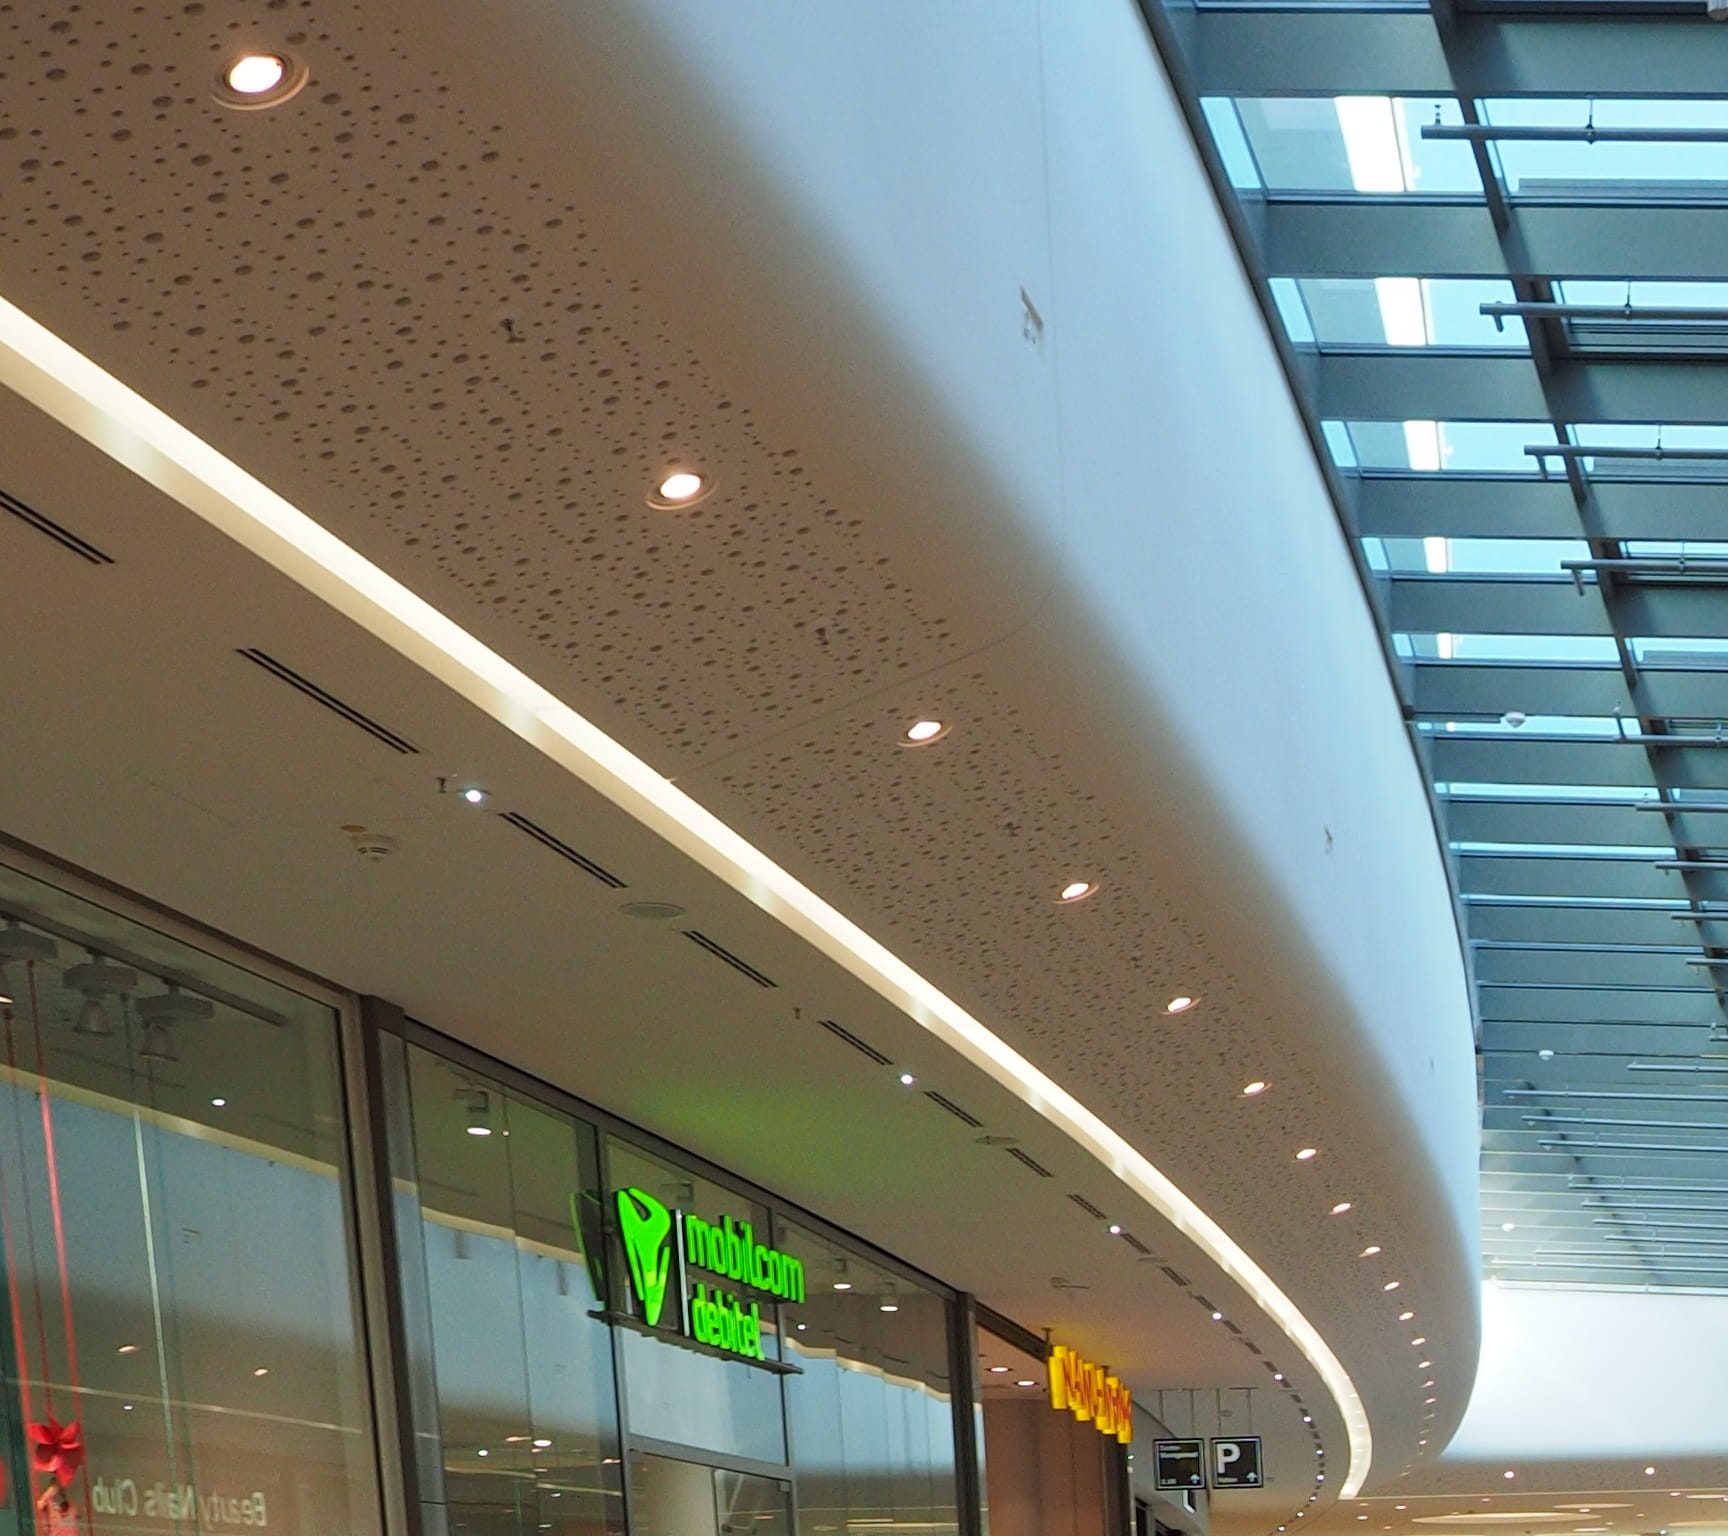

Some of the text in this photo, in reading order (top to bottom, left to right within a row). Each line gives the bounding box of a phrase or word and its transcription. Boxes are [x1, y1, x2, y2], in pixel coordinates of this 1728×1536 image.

[685, 1214, 805, 1304] mobilcom
[692, 1283, 765, 1361] debitel
[1216, 1443, 1240, 1474] P
